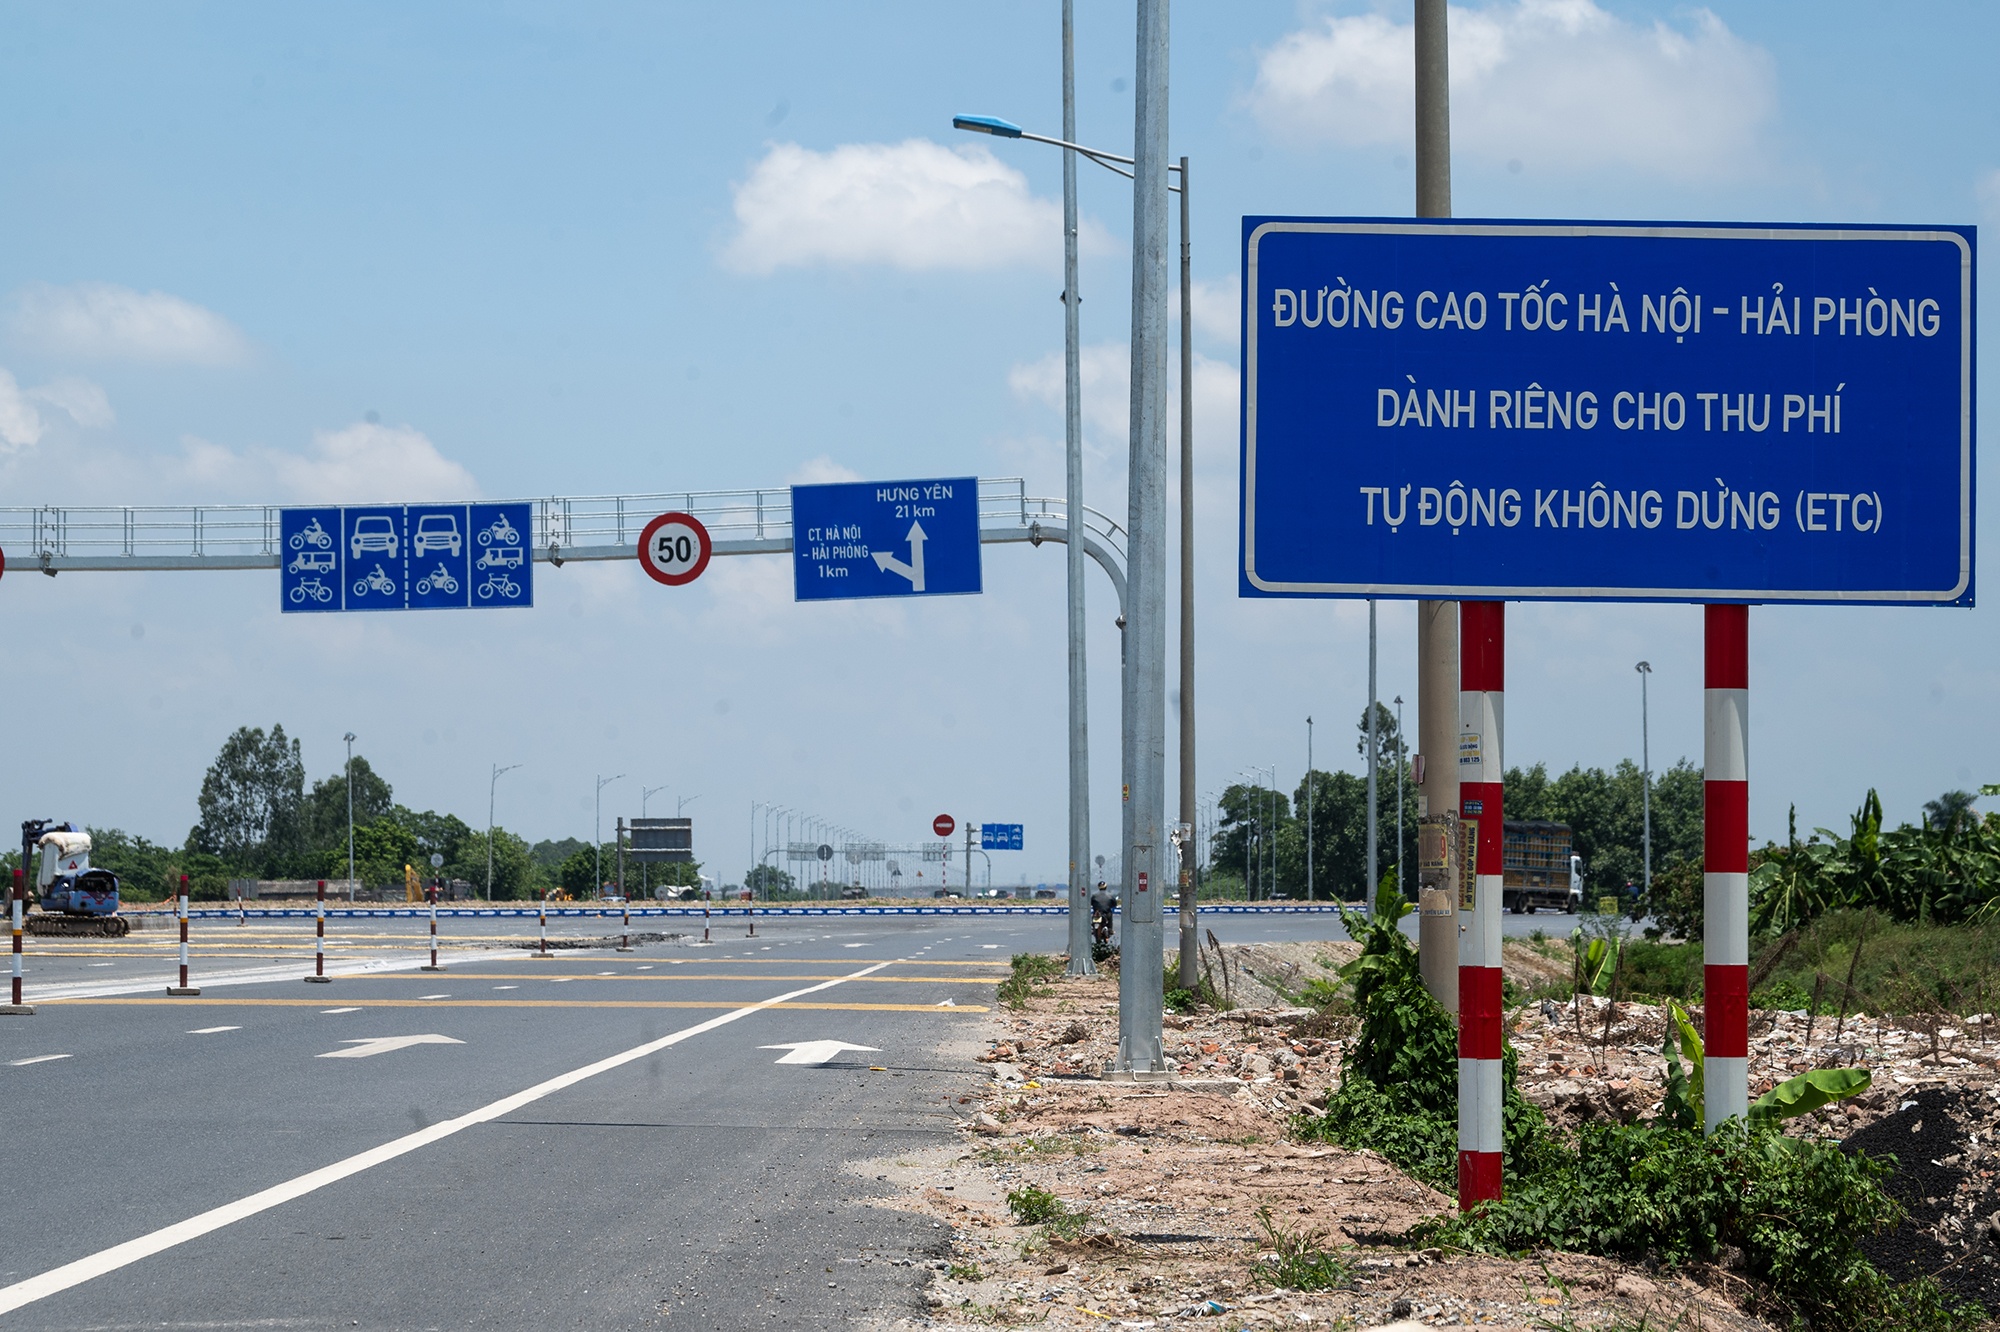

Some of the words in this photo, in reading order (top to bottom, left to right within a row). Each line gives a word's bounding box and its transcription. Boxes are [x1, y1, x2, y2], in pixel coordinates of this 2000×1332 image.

[1273, 276, 1404, 330] ĐƯỜNG
[1415, 290, 1487, 330] CAO
[1498, 279, 1568, 331] TỐC
[1578, 281, 1630, 333] HÀ
[1641, 286, 1701, 344] NỘI
[1713, 307, 1729, 315] -
[1741, 282, 1800, 335] HẢI
[1813, 287, 1940, 337] PHÒNG
[1377, 374, 1476, 428] DÀNH
[1489, 382, 1598, 430] RIÊNG
[1613, 391, 1686, 431] CHO
[1696, 393, 1771, 432] THU
[1783, 382, 1846, 433] PHÍ
[877, 487, 919, 502] HƯNG
[923, 483, 953, 500] YÊN
[896, 505, 909, 518] 21
[914, 504, 935, 517] km
[1360, 483, 1412, 534] TỰ
[1419, 480, 1522, 536] ĐỘNG
[1534, 481, 1663, 529] KHÔNG
[1676, 477, 1780, 530] DỪNG
[1795, 489, 1883, 534] (ETC)
[809, 528, 823, 542] CT.
[826, 524, 840, 541] HÀ
[843, 524, 861, 542] NỘI
[658, 536, 691, 563] 50
[812, 543, 830, 560] HẢI
[833, 543, 869, 559] PHÒNG
[818, 565, 824, 578] 1
[826, 565, 848, 578] km
